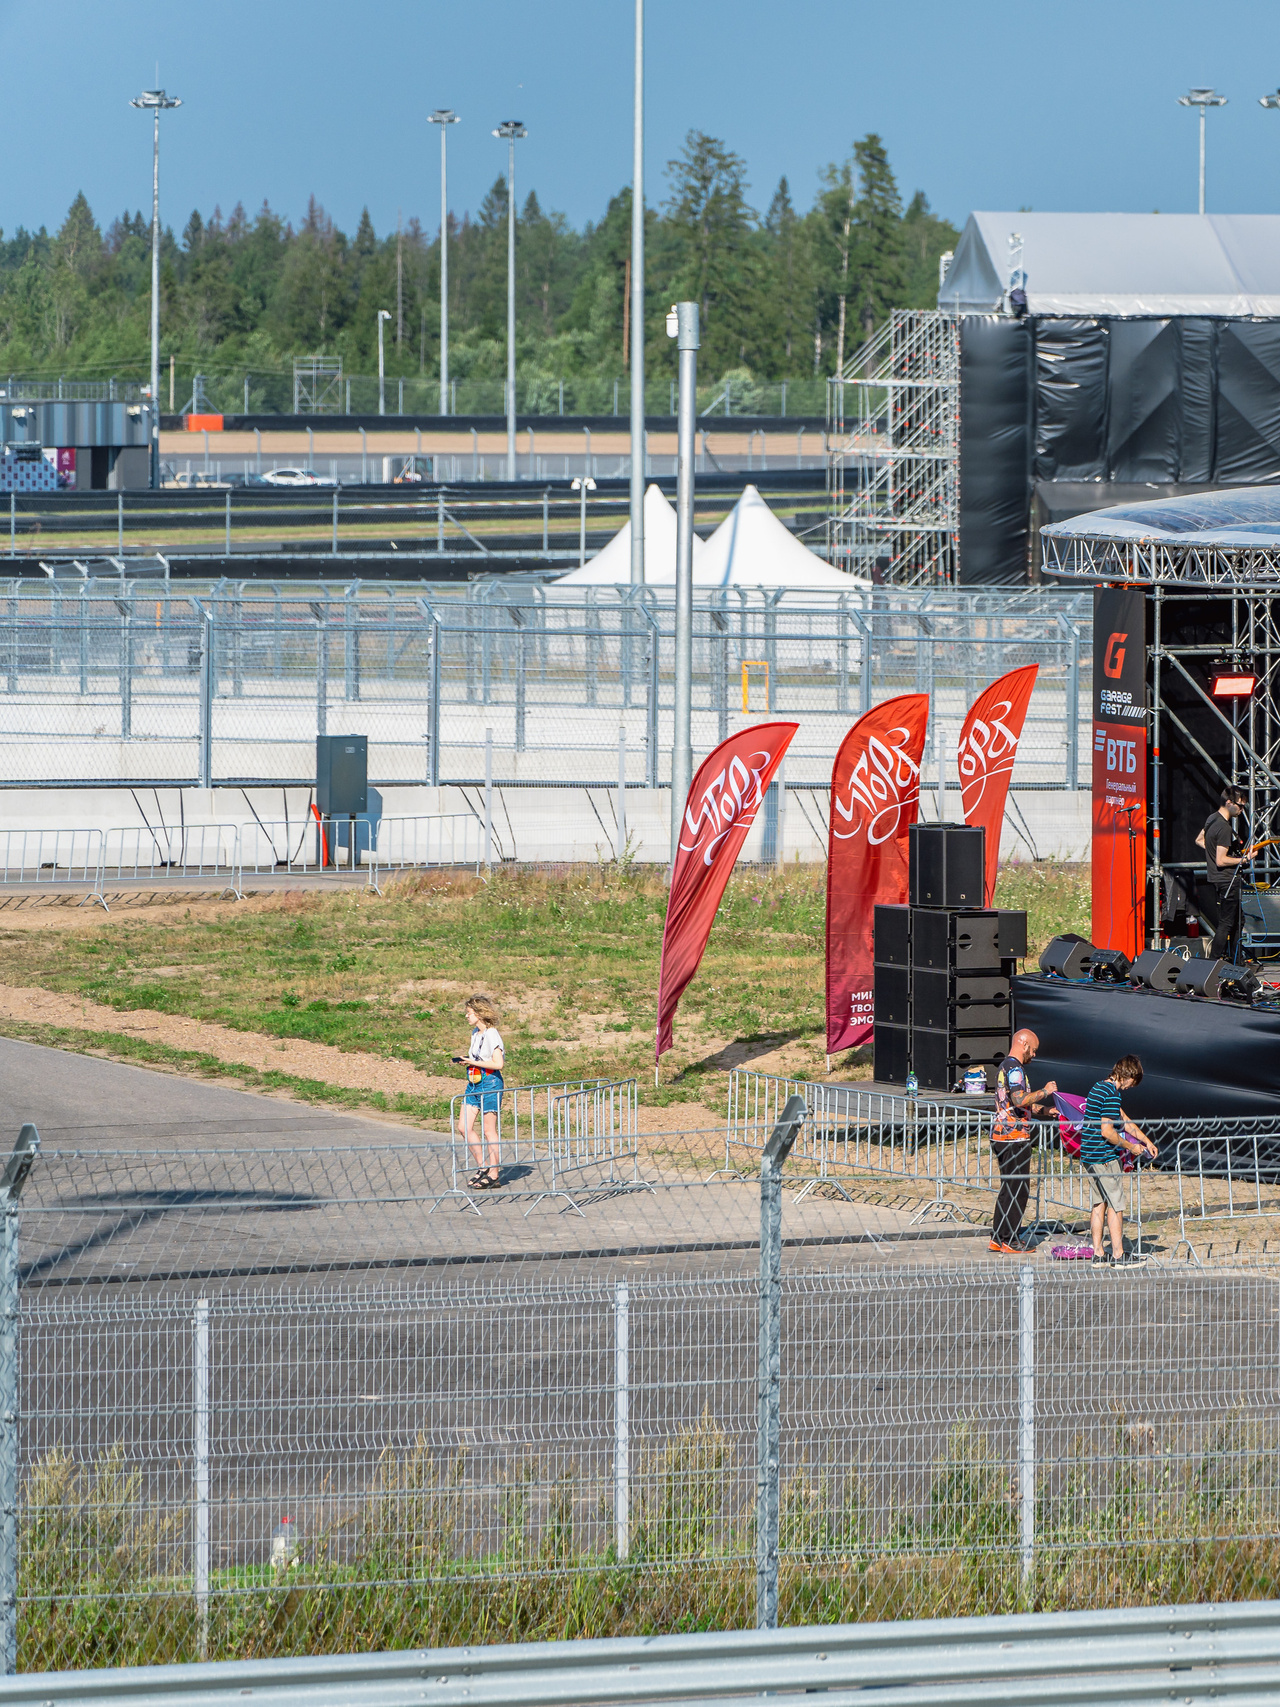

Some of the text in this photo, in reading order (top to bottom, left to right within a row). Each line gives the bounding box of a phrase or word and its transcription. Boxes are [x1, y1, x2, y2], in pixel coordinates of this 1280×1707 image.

[1106, 738, 1137, 774] ВТБ
[1105, 778, 1137, 794] Генеральный
[850, 1003, 875, 1013] ТВО
[850, 1015, 875, 1026] ЭМО
